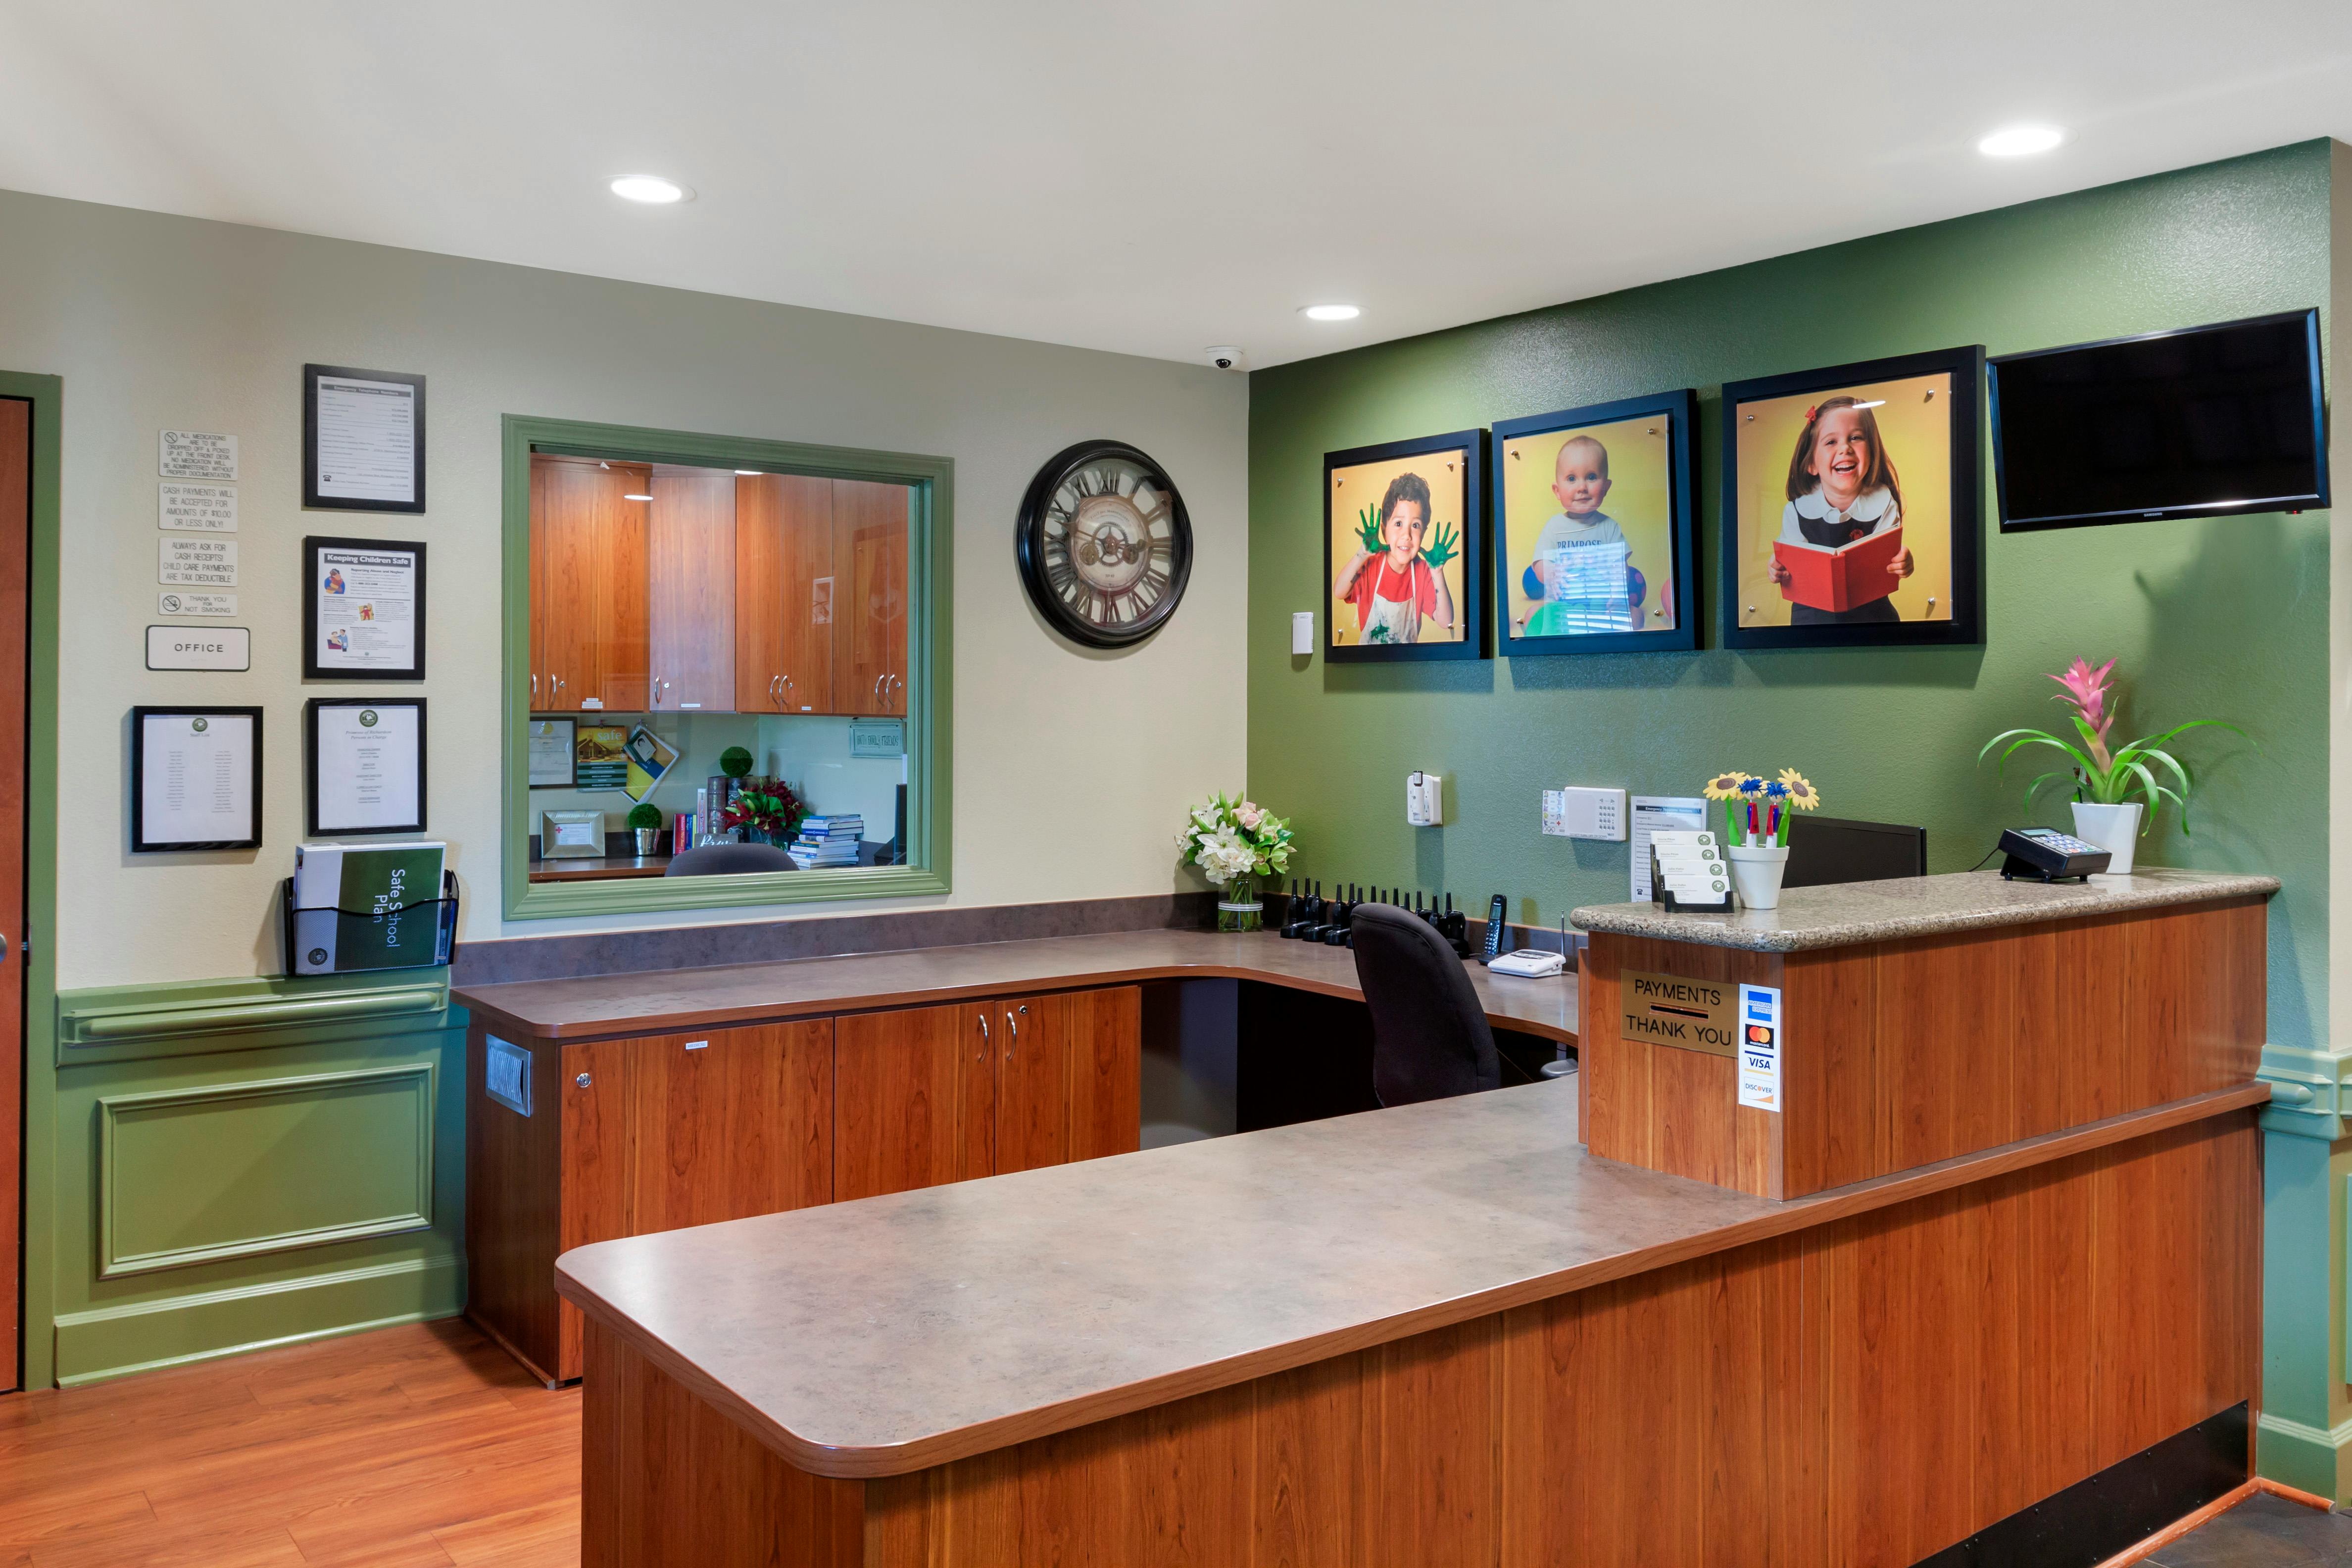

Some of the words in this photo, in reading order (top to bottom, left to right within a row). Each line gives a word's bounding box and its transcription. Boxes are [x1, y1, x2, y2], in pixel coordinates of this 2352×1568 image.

[183, 488, 216, 496] PAYMENTS
[181, 498, 212, 506] ACCEPTED
[327, 554, 358, 563] Keeping
[196, 574, 231, 583] DEDUCTIBLE
[174, 643, 224, 652] OFFICE
[597, 729, 622, 741] safe
[390, 869, 405, 898] Safe
[373, 895, 388, 923] Plan
[1635, 980, 1720, 1006] PAYMENTS
[1626, 1015, 1686, 1039] THANK
[1695, 1026, 1731, 1046] YOU
[1748, 1057, 1770, 1070] VISA
[1745, 1083, 1772, 1093] DISCOVER
